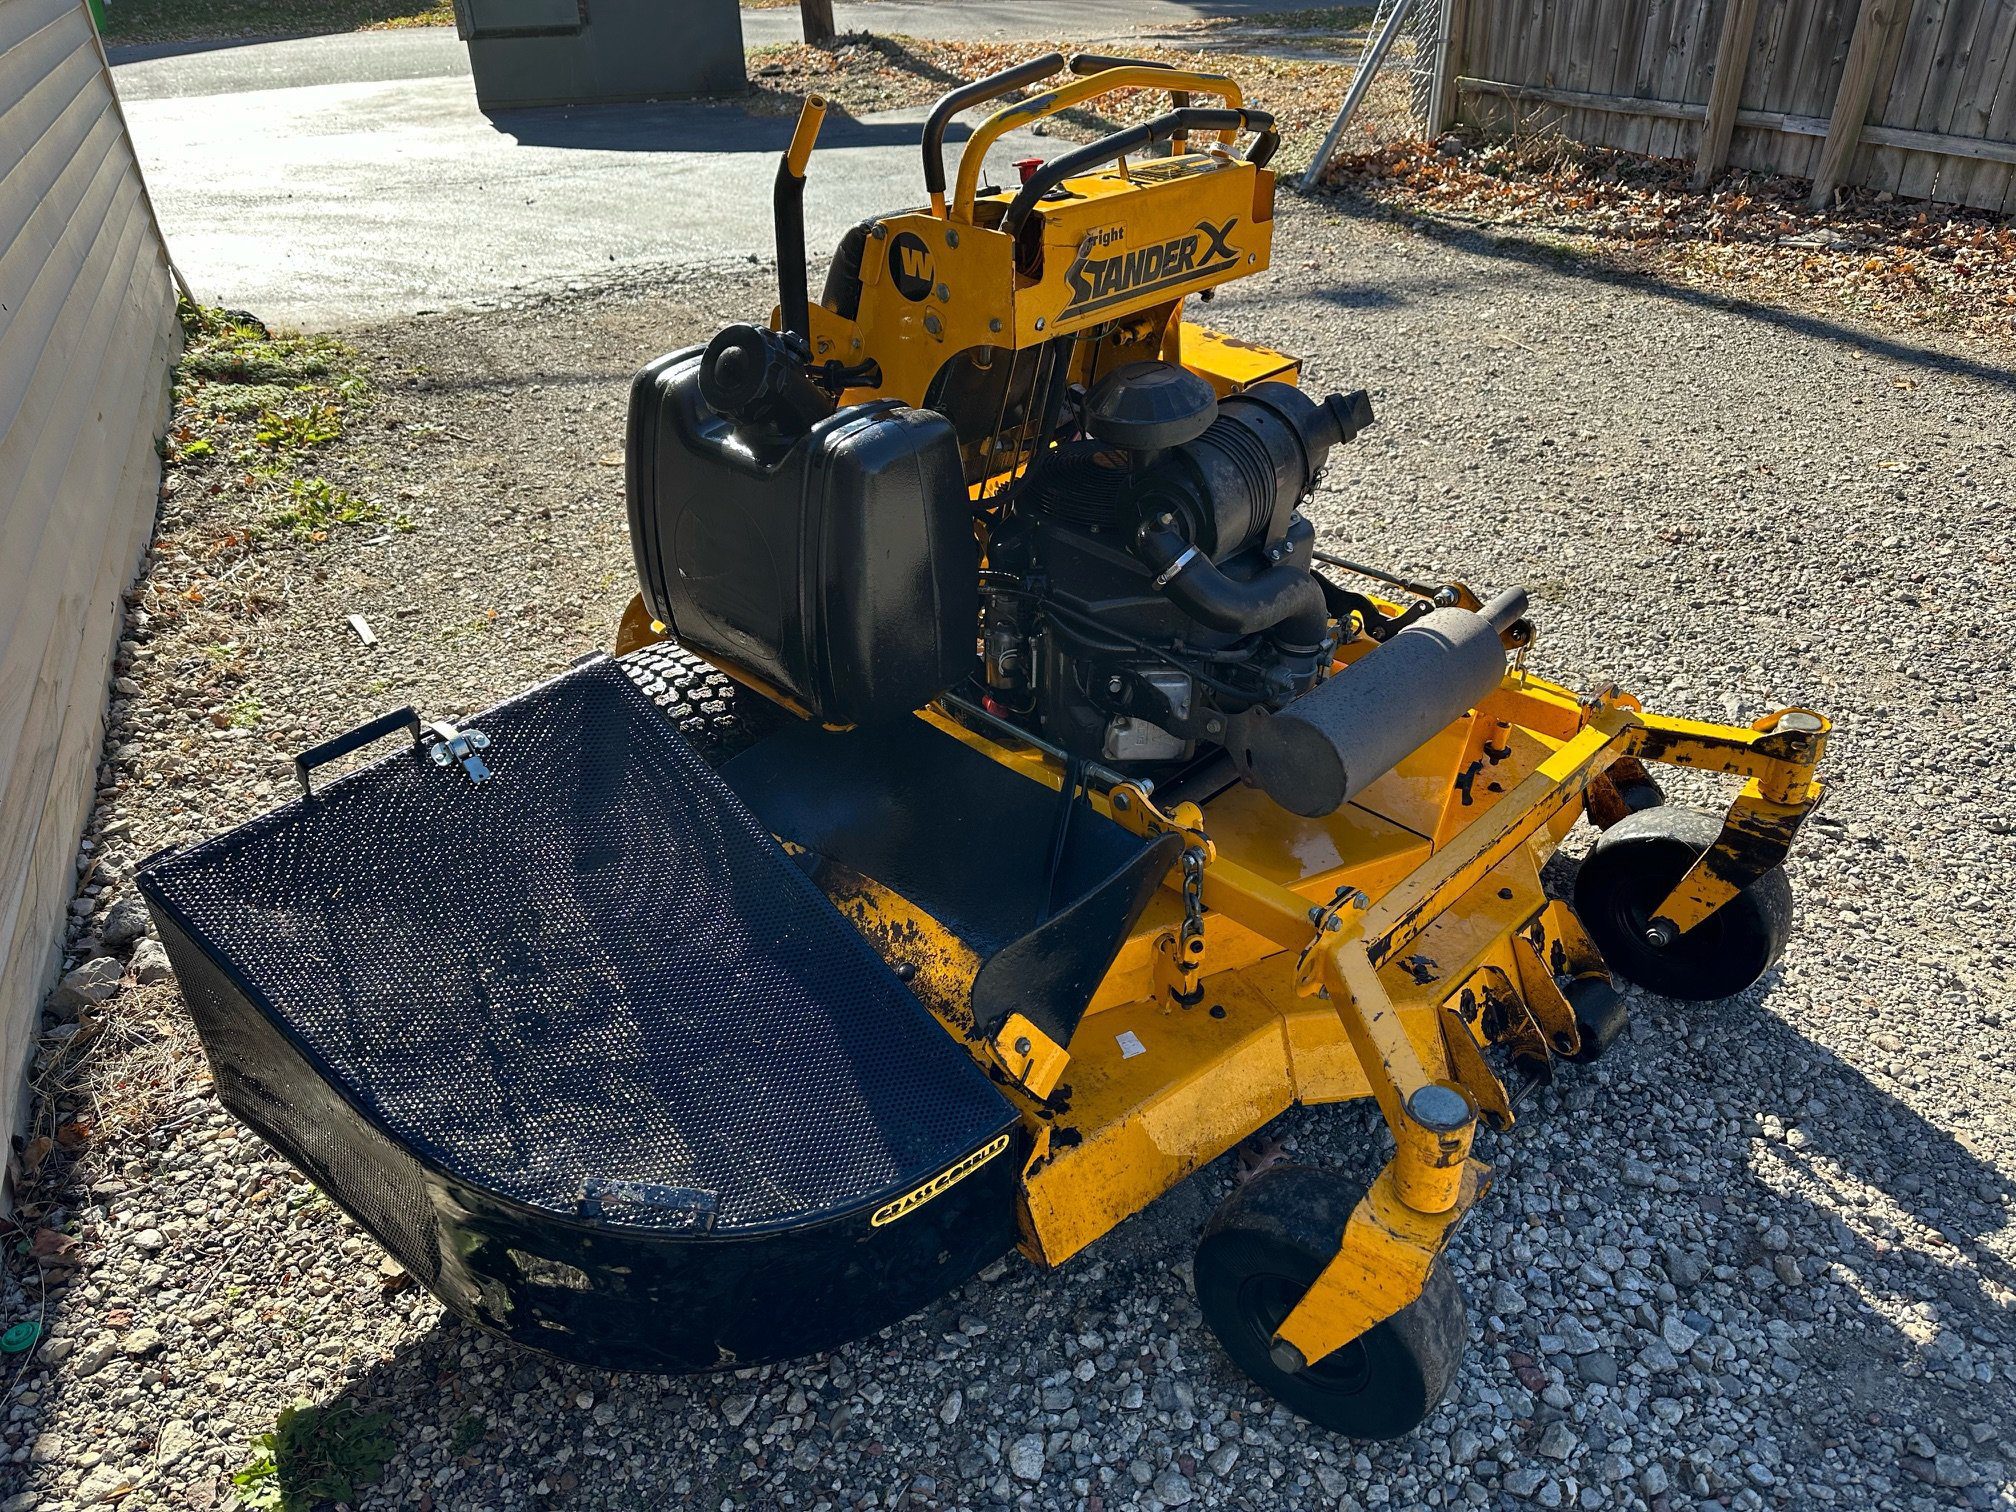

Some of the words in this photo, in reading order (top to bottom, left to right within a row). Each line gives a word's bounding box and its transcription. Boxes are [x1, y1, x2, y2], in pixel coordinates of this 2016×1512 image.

[901, 246, 934, 282] W
[1066, 234, 1198, 306] STANDER
[1195, 218, 1239, 266] X
[1090, 226, 1124, 247] right
[876, 1185, 933, 1222] GRASS
[935, 1138, 1006, 1190] GOBBLER
